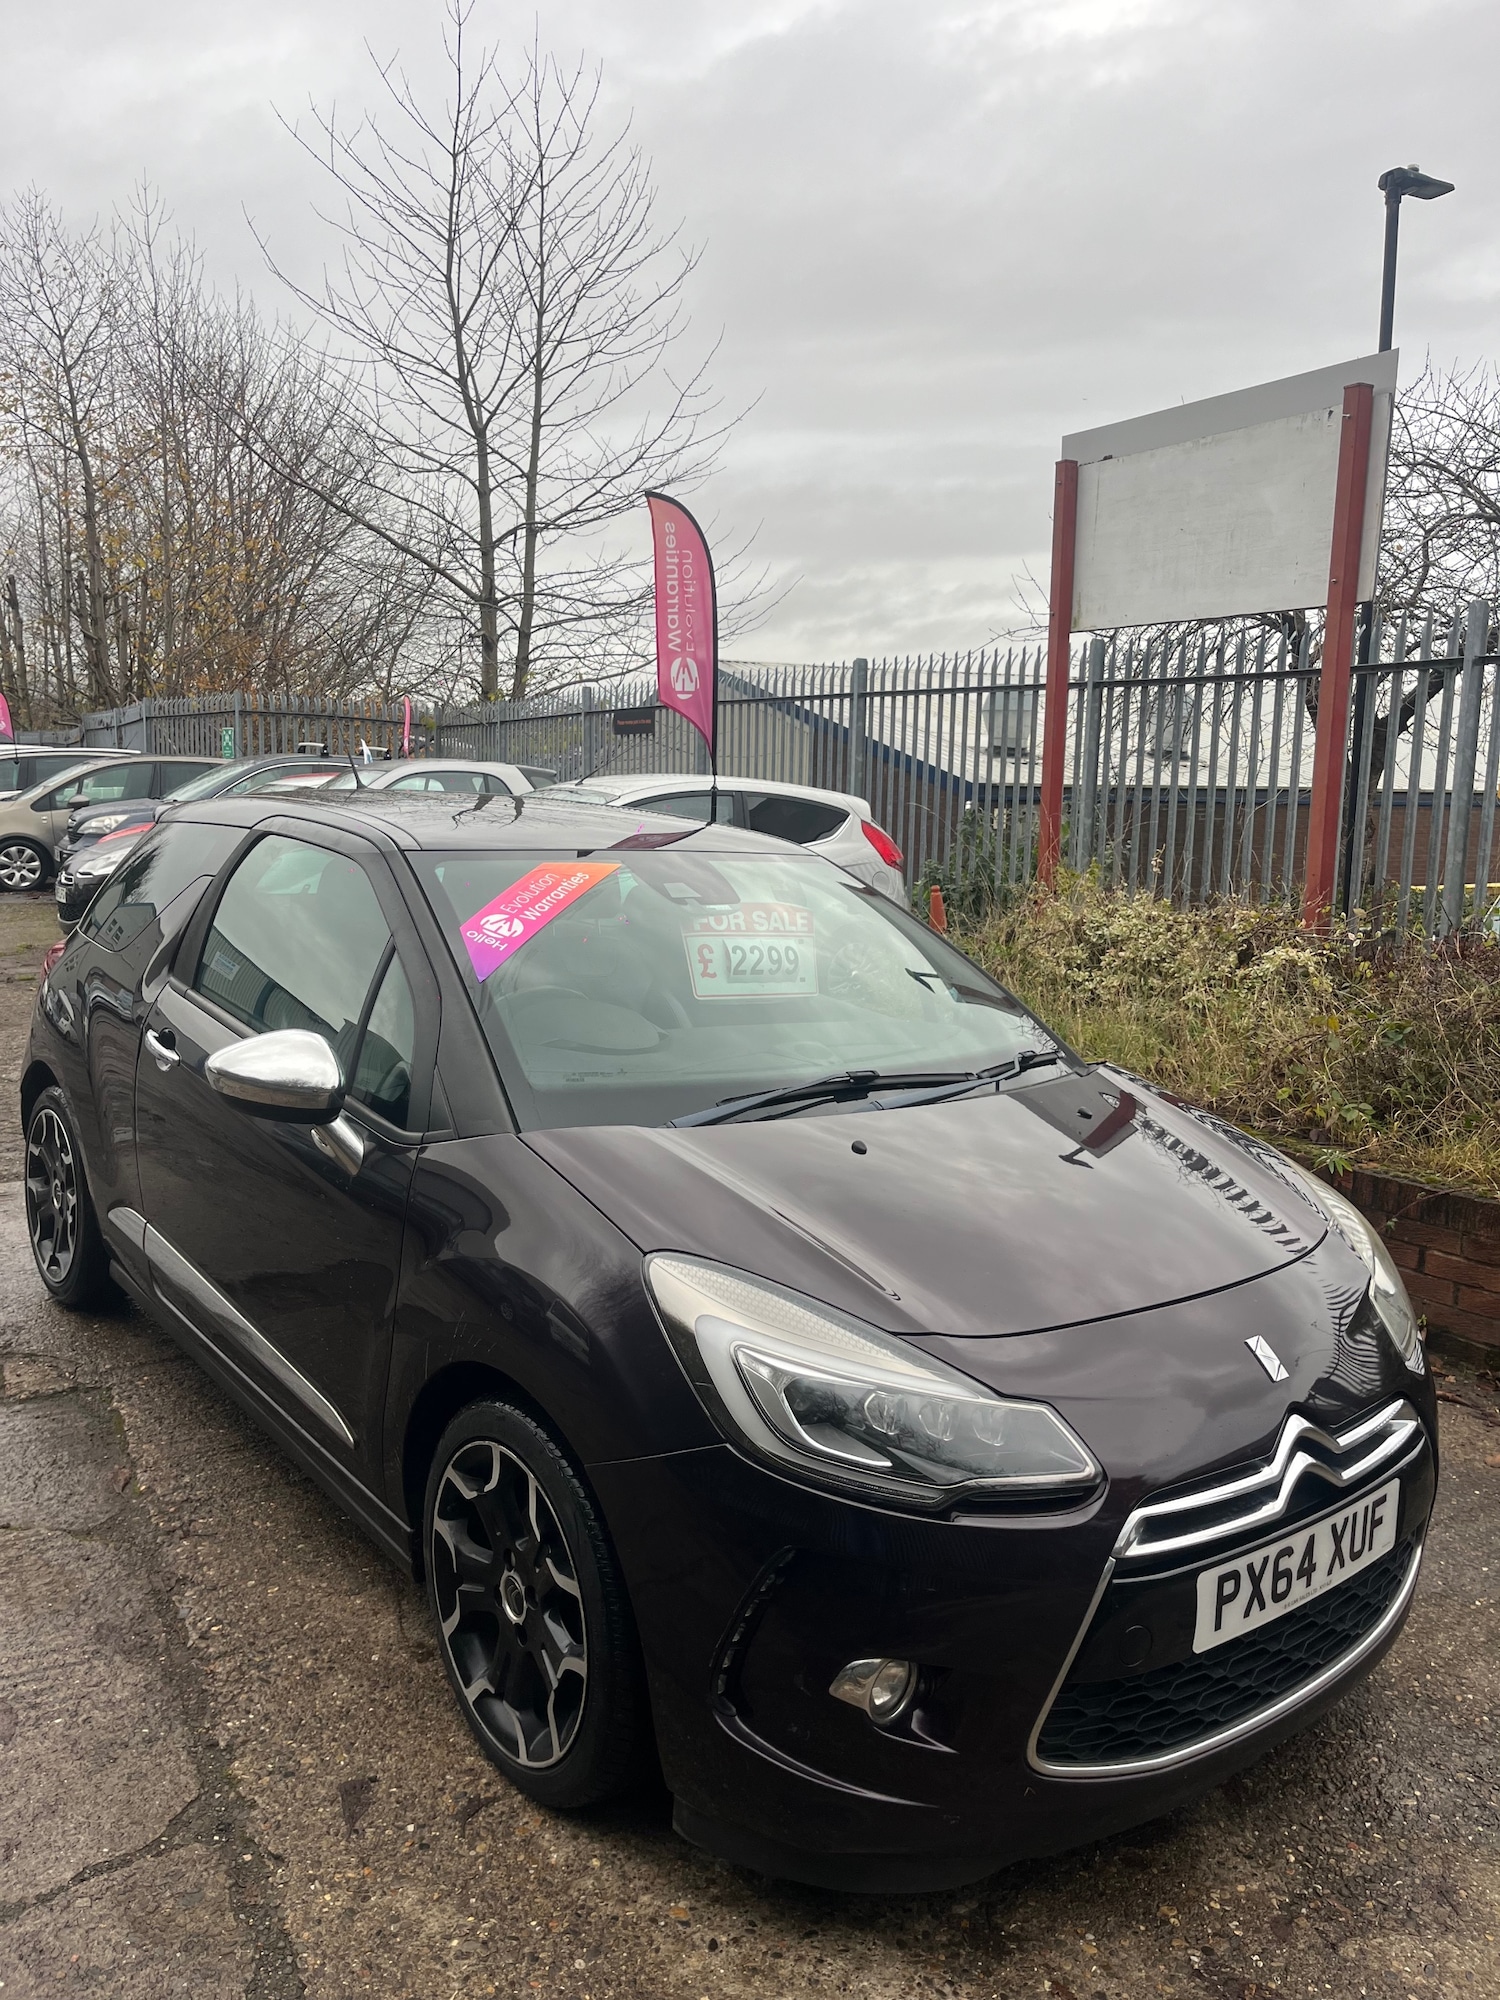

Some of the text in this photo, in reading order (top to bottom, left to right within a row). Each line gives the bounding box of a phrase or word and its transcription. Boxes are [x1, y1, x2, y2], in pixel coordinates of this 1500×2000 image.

[499, 872, 560, 914] Evolution
[518, 871, 590, 921] Warranties
[466, 929, 509, 951] Hello
[751, 910, 809, 932] SALE
[696, 943, 800, 979] £ 2299
[1213, 1493, 1388, 1633] PX64 XUF
